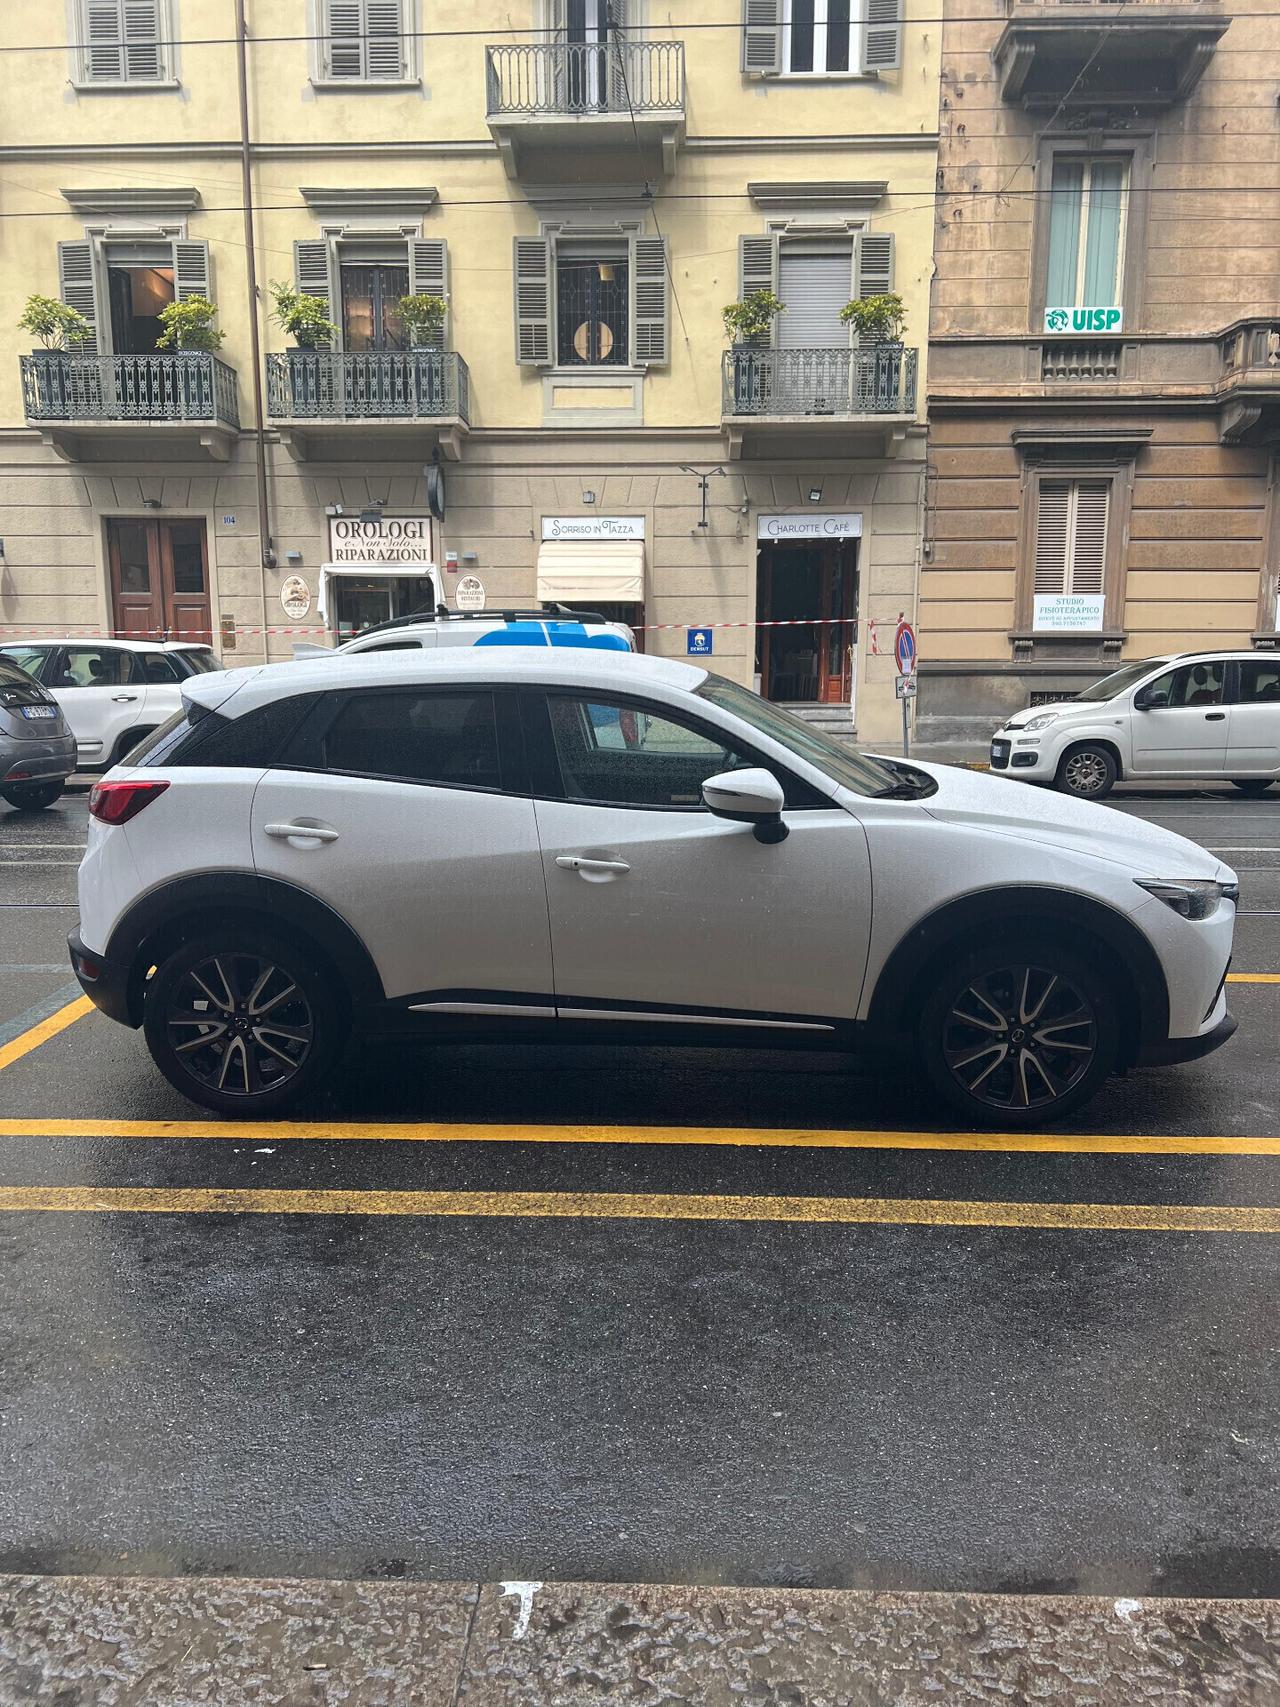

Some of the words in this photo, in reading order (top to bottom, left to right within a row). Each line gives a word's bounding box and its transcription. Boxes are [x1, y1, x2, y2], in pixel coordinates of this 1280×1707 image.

[1072, 309, 1121, 331] UISP
[223, 516, 236, 524] 104
[601, 520, 634, 534] TAZZA
[767, 519, 820, 535] CHARLOTTE
[335, 521, 425, 539] OROLOGI
[335, 548, 428, 561] RIPARAZIONI
[1039, 606, 1100, 614] FISIOTERAPICO
